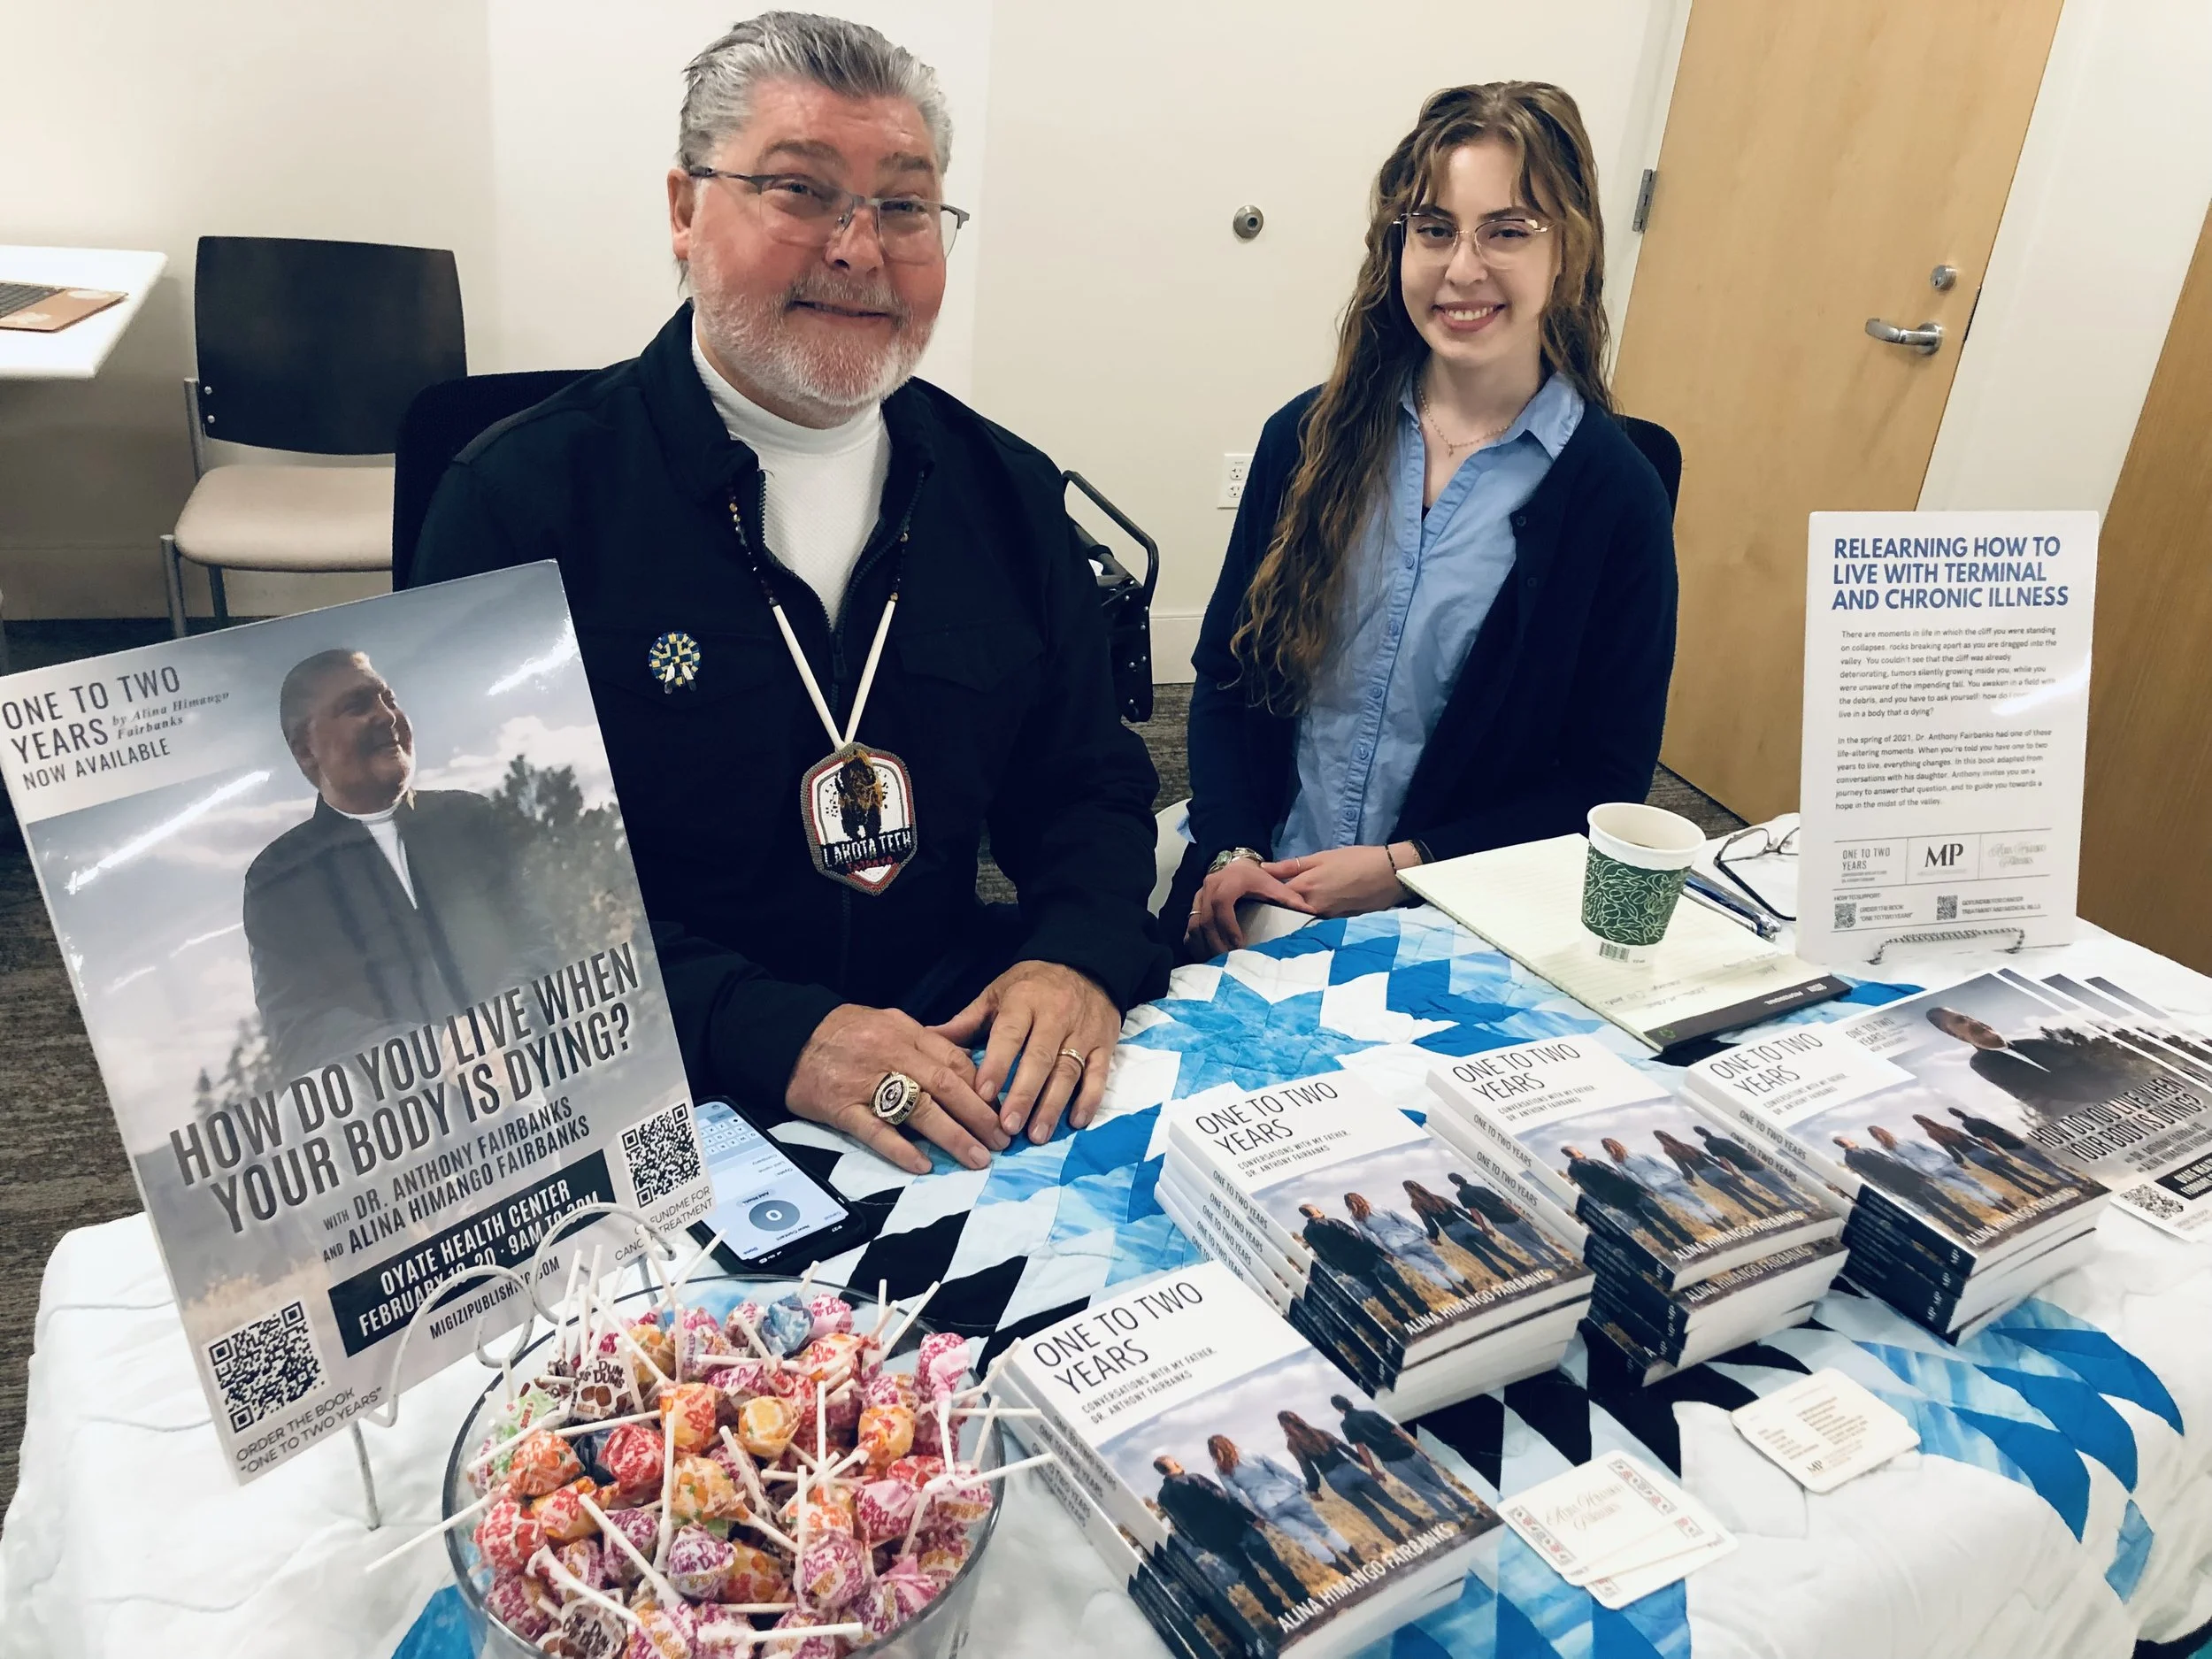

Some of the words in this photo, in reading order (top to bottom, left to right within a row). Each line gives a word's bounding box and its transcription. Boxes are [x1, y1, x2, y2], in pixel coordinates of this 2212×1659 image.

[1834, 537, 1968, 558] RELEARNING
[1974, 536, 2027, 557] HOW
[2033, 536, 2061, 557] TO
[1833, 564, 1878, 584] LIVE
[1884, 563, 1939, 583] WITH
[1945, 562, 2047, 582] TERMINAL
[1832, 589, 1879, 610] AND
[1886, 588, 1983, 609] CHRONIC
[1988, 586, 2069, 607] ILLNESS
[2026, 626, 2056, 635] standing
[1946, 668, 1972, 677] growing
[3, 692, 63, 730] ONE
[70, 682, 109, 714] TO
[117, 666, 180, 703] TWO
[112, 716, 127, 726] by
[133, 707, 167, 722] Alina
[173, 692, 229, 711] Himango
[12, 718, 108, 764] YEARS
[117, 716, 183, 739] Fairbanks
[23, 764, 65, 790] NOW
[76, 738, 171, 777] AVAILABLE
[823, 839, 877, 867] LAKOTA
[879, 830, 911, 853] TECH
[1842, 849, 1858, 860] ONE
[1862, 849, 1870, 858] TO
[1874, 847, 1891, 857] TWO
[1842, 861, 1867, 871] YEARS
[1924, 843, 1963, 867] MP
[170, 1092, 282, 1187] HOW
[291, 1064, 354, 1133] DO
[356, 1025, 442, 1102] YOU
[446, 988, 531, 1064] LIVE
[533, 942, 641, 1025] WHEN
[1453, 1058, 1505, 1083] ONE
[1496, 1053, 1533, 1070] TO
[1526, 1044, 1580, 1064] TWO
[1709, 1053, 1759, 1079] ONE
[1747, 1046, 1783, 1064] TO
[1772, 1033, 1824, 1055] TWO
[1472, 1072, 1545, 1102] YEARS
[1733, 1064, 1801, 1097] YEARS
[210, 1137, 340, 1233] YOUR
[342, 1083, 451, 1176] BODY
[457, 1064, 501, 1123] IS
[504, 1002, 630, 1102] DYING?
[1195, 1105, 1252, 1134] ONE
[1245, 1095, 1284, 1117] TO
[1279, 1082, 1339, 1107] TWO
[2027, 1122, 2076, 1150] HOW
[2062, 1114, 2096, 1135] DO
[2083, 1097, 2123, 1125] YOU
[2110, 1092, 2150, 1116] LIVE
[2131, 1075, 2187, 1106] WHEN
[1213, 1118, 1293, 1156] YEARS
[1237, 1145, 1294, 1170] CONVERSATIONS
[1293, 1139, 1311, 1152] WITH
[1312, 1136, 1323, 1145] MY
[1474, 1114, 1486, 1130] ONE
[1488, 1125, 1495, 1137] TO
[1497, 1133, 1511, 1149] TWO
[1512, 1145, 1532, 1168] YEARS
[2063, 1130, 2117, 1164] YOUR
[2099, 1118, 2150, 1148] BODY
[2133, 1113, 2166, 1132] IS
[323, 1209, 349, 1230] WITH
[353, 1188, 388, 1220] DR.
[393, 1142, 474, 1201] ANTHONY
[477, 1096, 573, 1157] FAIRBANKS
[1245, 1168, 1259, 1178] DR.
[1261, 1155, 1294, 1172] ANTHONY
[1293, 1145, 1331, 1161] FAIRBANKS
[323, 1242, 344, 1263] AND
[348, 1208, 406, 1254] ALINA
[408, 1162, 494, 1222] HIMANGO
[496, 1115, 590, 1179] FAIRBANKS
[635, 1197, 690, 1235] FUNDME
[691, 1186, 710, 1202] FOR
[1213, 1170, 1225, 1186] ONE
[1226, 1182, 1234, 1195] TO
[1235, 1191, 1248, 1209] TWO
[1249, 1205, 1268, 1230] YEARS
[380, 1248, 438, 1295] OYATE
[441, 1213, 506, 1264] HEALTH
[508, 1179, 571, 1228] CENTER
[508, 1221, 544, 1255] 9AM
[1672, 1241, 1708, 1263] ALINA
[1706, 1225, 1754, 1249] HIMANGO
[1750, 1210, 1804, 1232] FAIRBANKS
[1033, 1323, 1101, 1367] ONE
[1093, 1307, 1139, 1336] TO
[1133, 1282, 1202, 1319] TWO
[1403, 1311, 1443, 1335] ALINA
[1438, 1289, 1495, 1318] HIMANGO
[1494, 1269, 1554, 1298] FAIRBANKS
[593, 1370, 625, 1388] DUMS
[598, 1360, 624, 1378] DUM
[1054, 1339, 1149, 1394] YEARS
[1081, 1376, 1150, 1414] CONVERSATIONS
[1148, 1365, 1169, 1382] WITH
[1171, 1359, 1184, 1371] MY
[1110, 1392, 1148, 1415] ANTHONY
[1149, 1371, 1193, 1395] FAIRBANKS
[236, 1429, 286, 1462] ORDER
[287, 1410, 314, 1438] THE
[316, 1387, 356, 1420] BOOK
[279, 1436, 300, 1456] TO
[301, 1416, 335, 1442] TWO
[1277, 1597, 1325, 1633] ALINA
[1317, 1560, 1386, 1607] HIMANGO
[1382, 1523, 1455, 1569] FAIRBANKS
